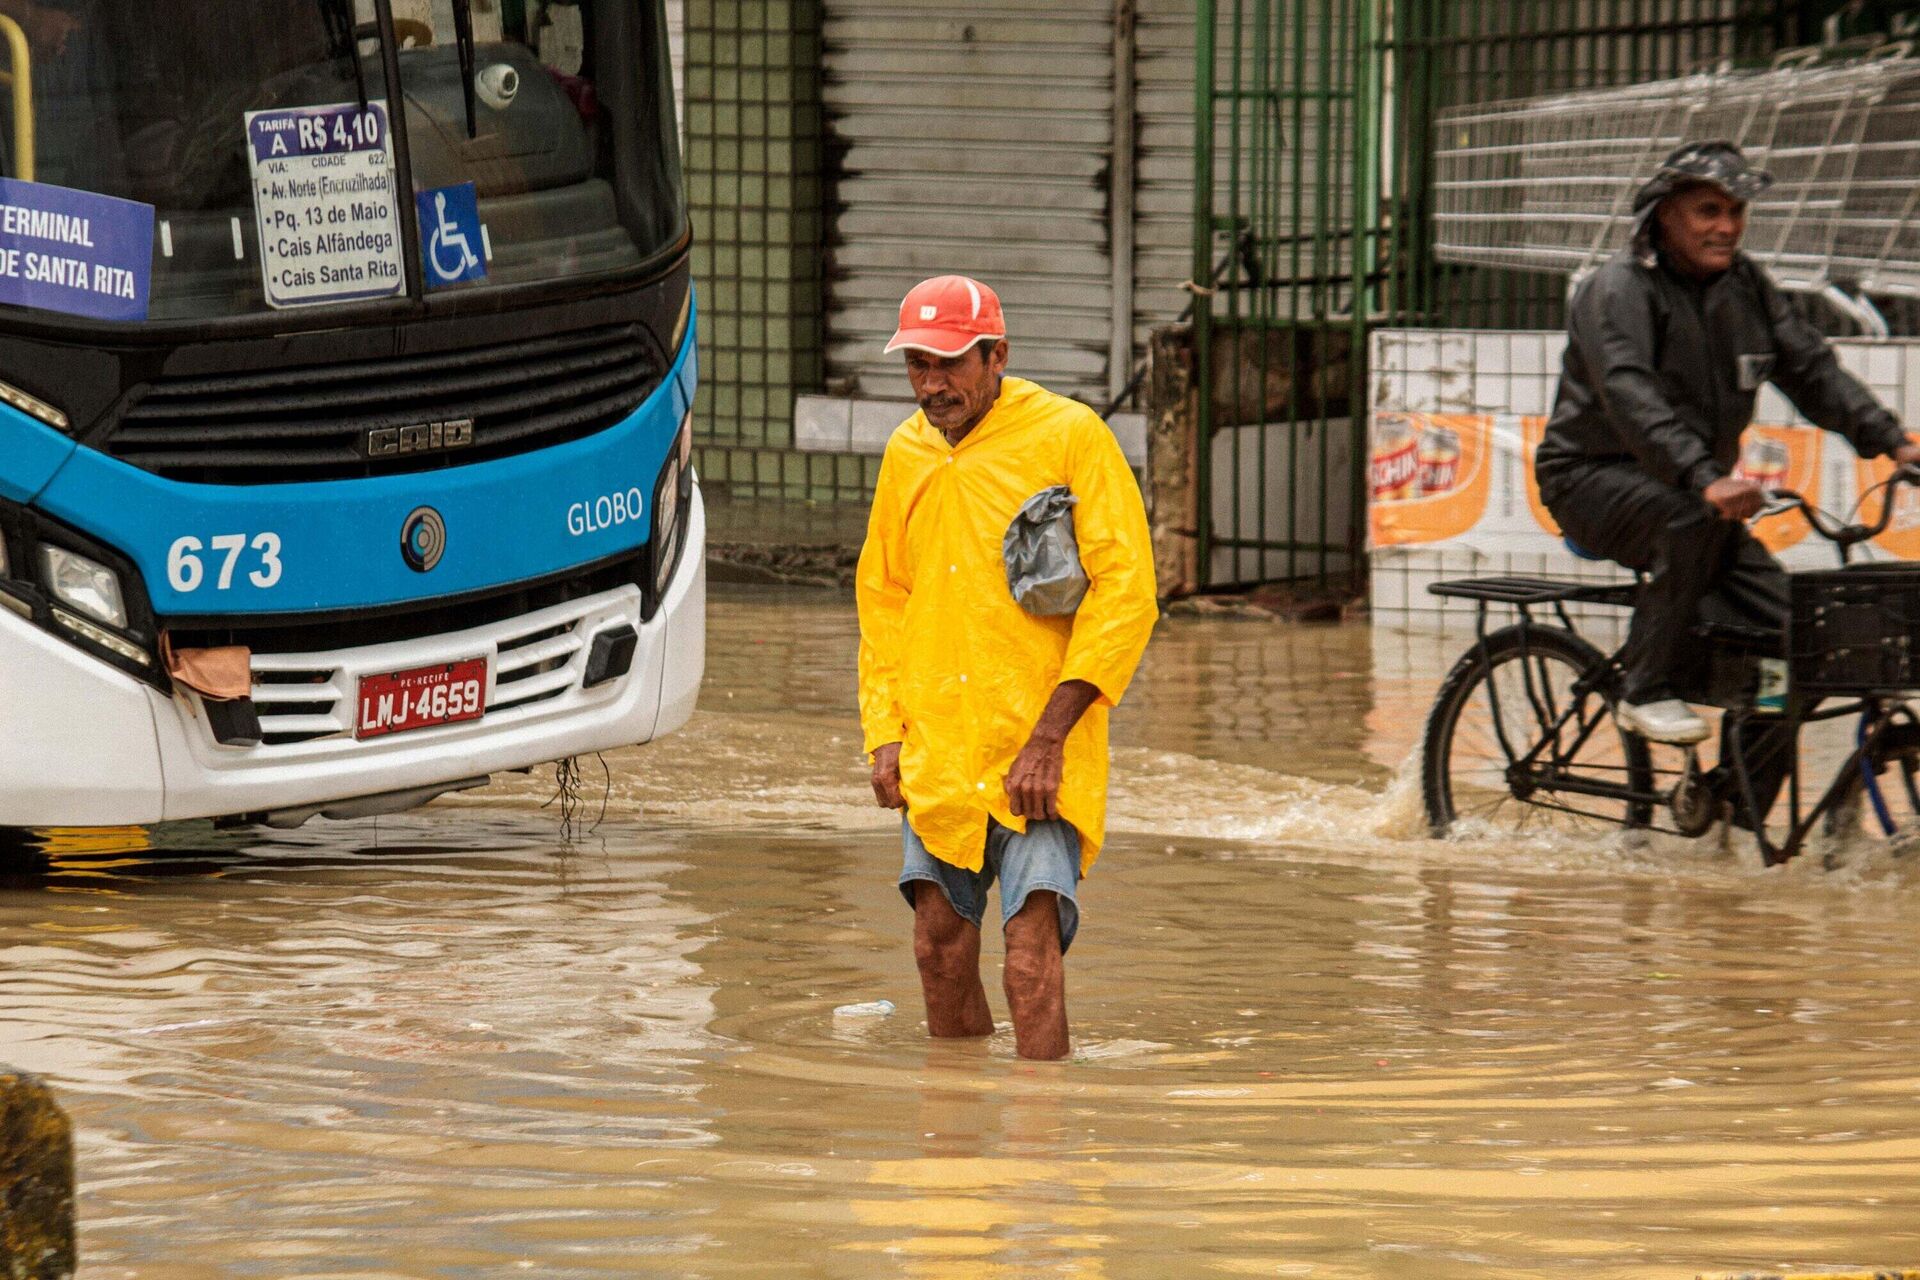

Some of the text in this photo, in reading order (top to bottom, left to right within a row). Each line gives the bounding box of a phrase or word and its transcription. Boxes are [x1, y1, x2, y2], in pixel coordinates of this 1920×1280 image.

[258, 118, 295, 132] TARIFA
[298, 112, 378, 151] R$ 4,10
[271, 133, 288, 155] A
[268, 153, 385, 174] VIA: CIDADE 622
[271, 171, 390, 200] Av. Norte (Encruzilhada)
[274, 201, 388, 231] Pq. 13 de Maio
[277, 230, 393, 258] Cais Alfândega
[24, 251, 89, 290] SANTA
[93, 264, 135, 300] RITA
[281, 260, 397, 287] Cais Santa Rita
[368, 420, 472, 456] CAIO
[567, 487, 643, 536] GLOBO
[167, 531, 282, 593] 673
